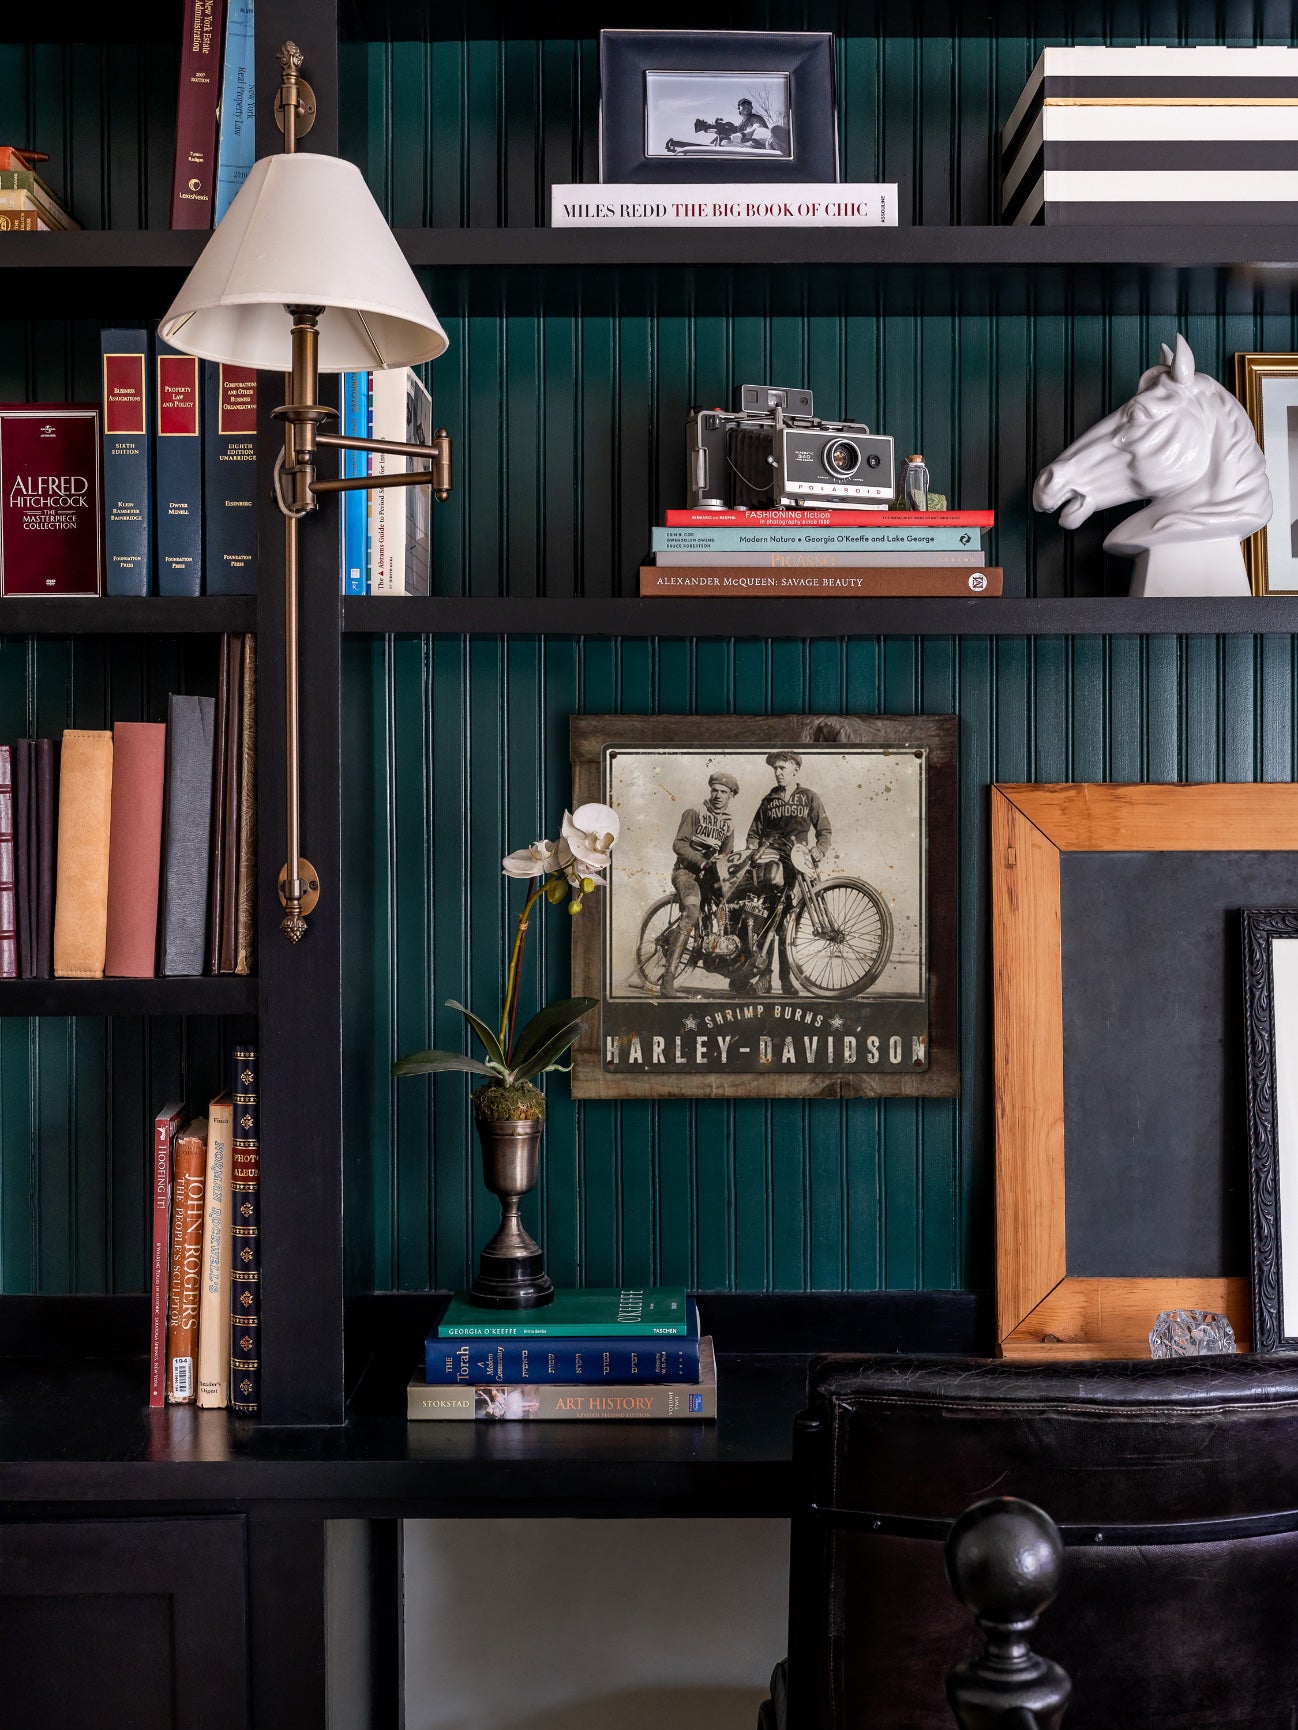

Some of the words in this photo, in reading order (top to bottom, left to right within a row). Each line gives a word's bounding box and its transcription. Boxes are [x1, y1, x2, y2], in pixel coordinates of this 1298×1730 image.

[204, 0, 214, 15] New
[192, 0, 204, 52] Administration
[203, 16, 213, 32] York
[202, 33, 212, 54] Estate
[237, 66, 247, 84] Real
[233, 86, 246, 118] Property
[246, 102, 255, 120] York
[234, 120, 243, 136] Law
[179, 192, 209, 201] LexisNexis
[562, 204, 615, 218] MILES
[621, 204, 668, 218] REDD
[672, 203, 708, 217] THE
[712, 203, 741, 217] BIG
[746, 203, 794, 217] BOOK
[797, 203, 821, 217] OF
[825, 203, 868, 217] CHIC
[10, 475, 88, 496] ALFRED
[798, 484, 881, 495] POLAROID
[9, 496, 89, 508] HITCHCOCK
[745, 511, 802, 519] FASHIONING
[804, 510, 831, 519] fiction
[23, 522, 77, 530] COLLECTION
[377, 524, 385, 543] Guide
[739, 535, 768, 543] Modern
[770, 535, 796, 543] Nature
[804, 535, 835, 545] Georgia
[836, 534, 870, 543] O'Keeffe
[871, 535, 885, 543] and
[887, 535, 905, 543] Lake
[906, 535, 935, 545] George
[377, 544, 385, 569] Abrams
[771, 552, 836, 567] PICASSO
[377, 577, 385, 590] The
[656, 577, 721, 586] ALEXANDER
[781, 578, 819, 587] SAVAGE
[822, 578, 864, 587] BEAUTY
[704, 1005, 764, 1029] SHRIMP
[774, 1005, 824, 1028] BURNS
[606, 1035, 925, 1064] HARLEY-DAVIDSON
[157, 1145, 167, 1193] HOOFING
[211, 1140, 225, 1203] NORMAN
[176, 1177, 185, 1202] THE
[157, 1196, 167, 1209] IT!
[185, 1174, 204, 1233] JOHN
[173, 1208, 184, 1261] PEOPLE'S
[209, 1207, 222, 1294] ROCKWELL'S
[181, 1243, 201, 1330] ROGERS
[170, 1265, 181, 1327] SCULPTOR
[617, 1289, 643, 1323] O'KEEFFE
[445, 1356, 453, 1373] THE
[456, 1346, 470, 1382] Torah
[496, 1346, 504, 1382] Commentary
[422, 1400, 470, 1408] STOKSTAD
[555, 1397, 585, 1410] ART
[589, 1397, 654, 1410] HISTORY
